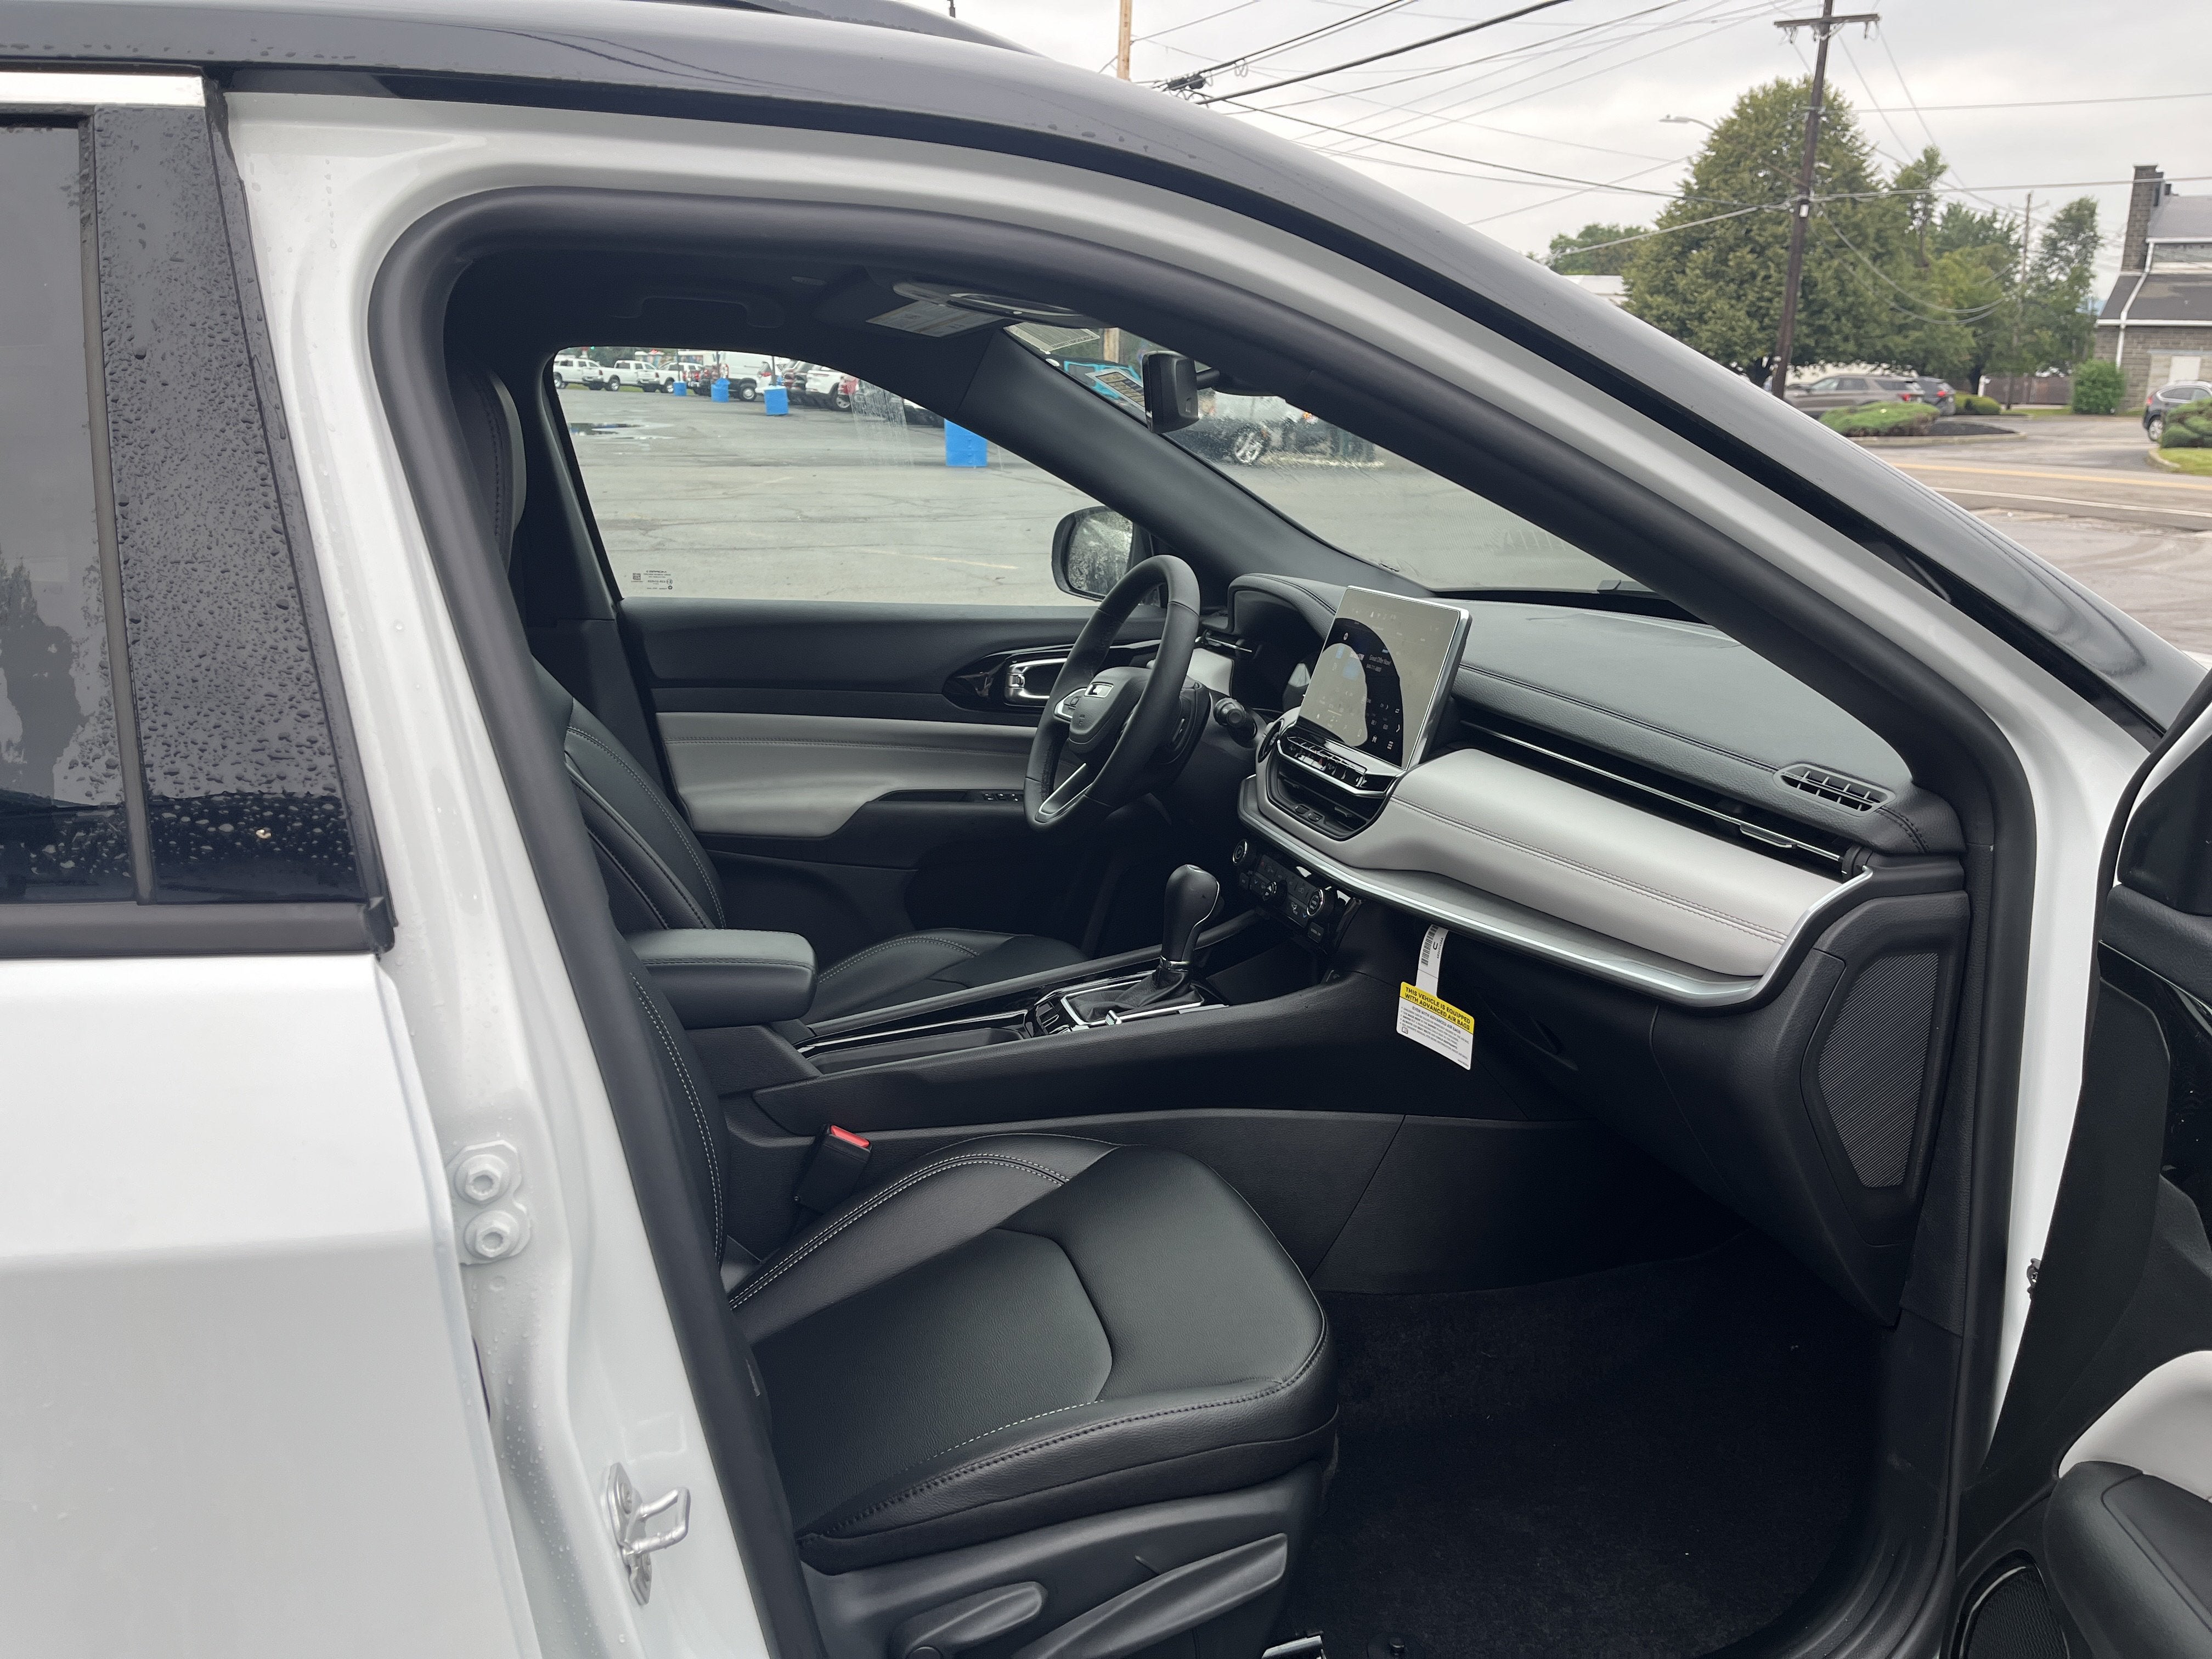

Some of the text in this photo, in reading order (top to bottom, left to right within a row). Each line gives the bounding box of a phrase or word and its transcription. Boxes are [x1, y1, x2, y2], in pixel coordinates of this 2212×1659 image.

[1781, 772, 1803, 780] AIRBAG
[1405, 993, 1418, 1002] WITH
[1419, 1001, 1447, 1017] ADVANCED
[1457, 1020, 1470, 1030] BAGS
[1406, 986, 1417, 996] THIS
[1418, 994, 1440, 1007] VEHICLE
[1447, 1007, 1470, 1024] EQUIPPED
[1430, 1015, 1447, 1026] ADVANCED
